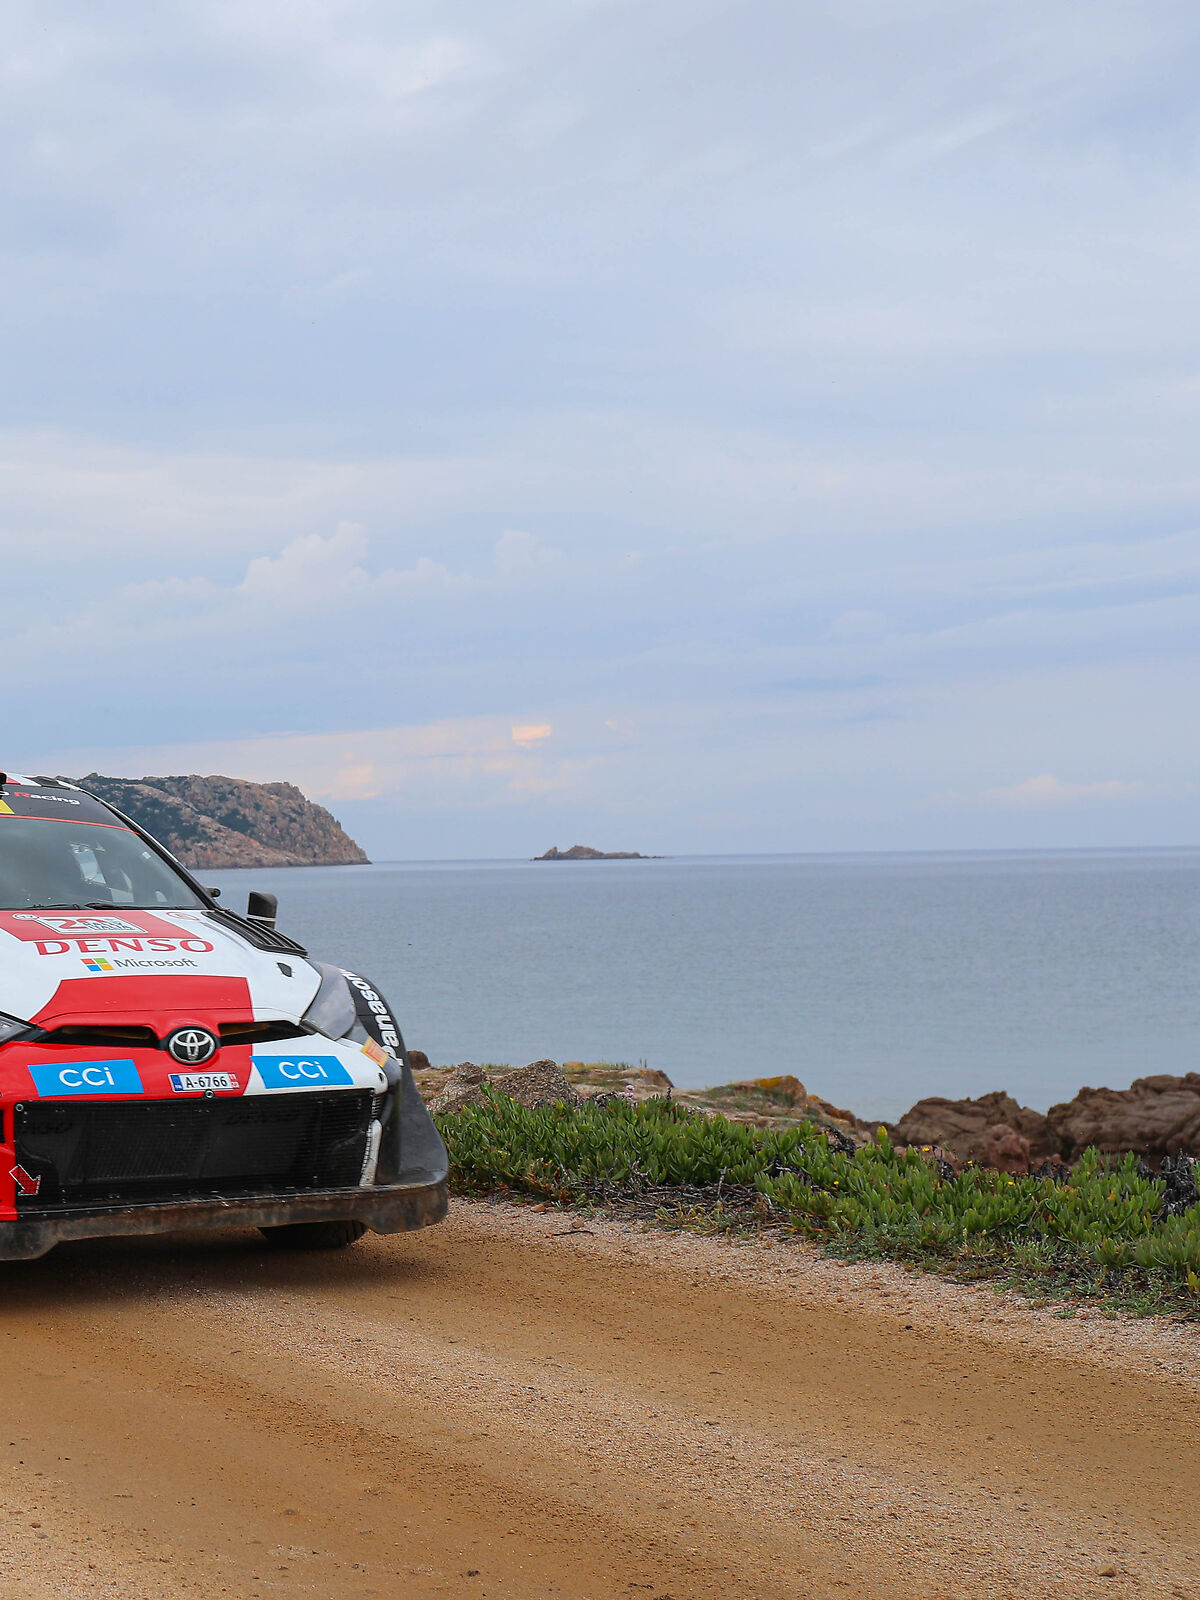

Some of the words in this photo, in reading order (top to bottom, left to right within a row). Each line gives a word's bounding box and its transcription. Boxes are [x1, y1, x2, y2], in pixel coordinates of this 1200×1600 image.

[14, 791, 81, 806] Racing
[33, 938, 215, 956] DENSO
[113, 958, 199, 968] Microsoft
[185, 1076, 227, 1089] A-6766
